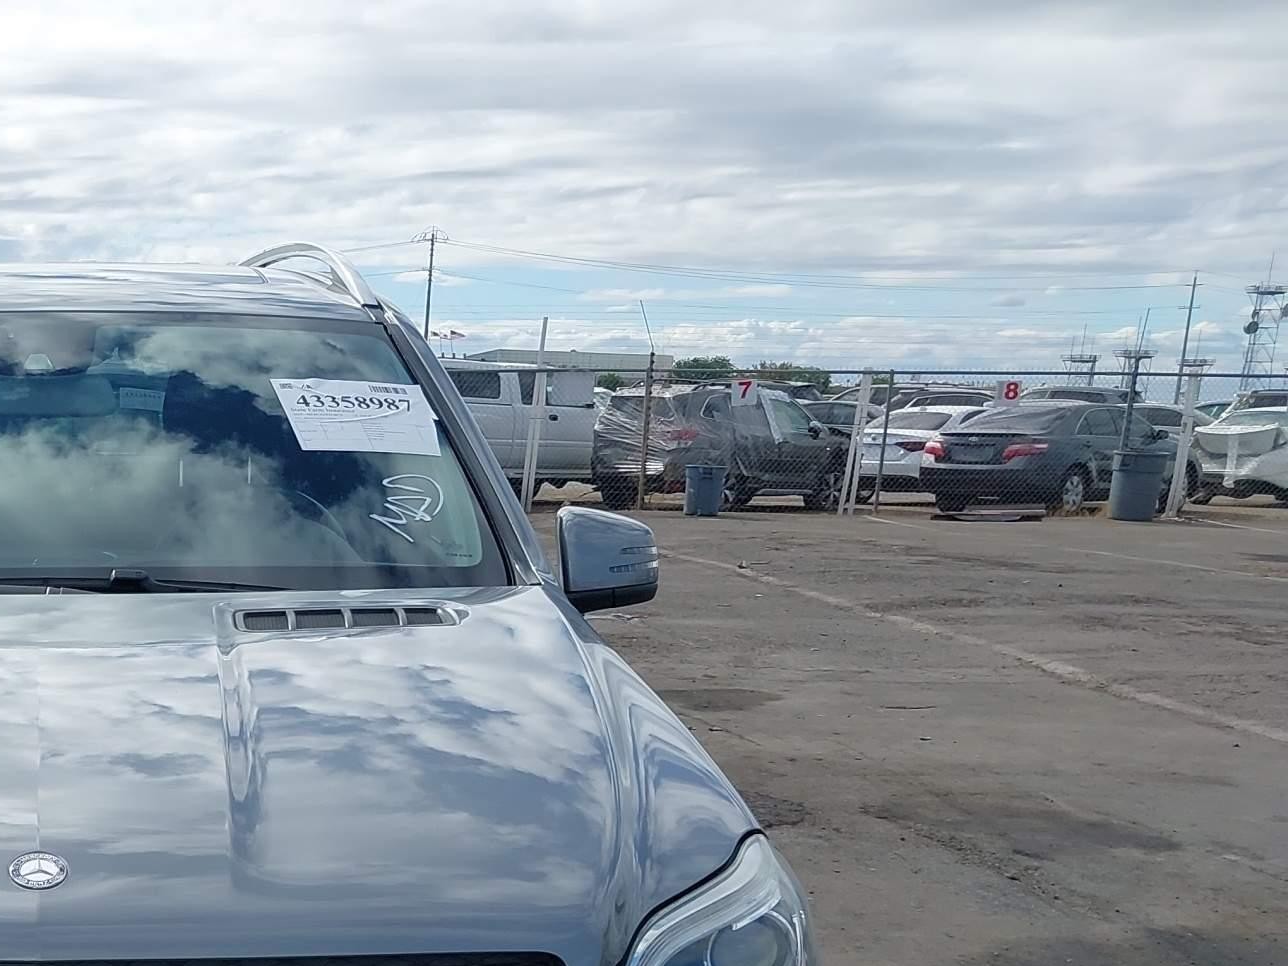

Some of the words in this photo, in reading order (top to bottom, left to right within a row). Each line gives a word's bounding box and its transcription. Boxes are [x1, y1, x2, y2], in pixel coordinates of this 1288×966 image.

[738, 381, 753, 399] 7
[1004, 382, 1019, 400] 8
[296, 393, 411, 412] 43358987
